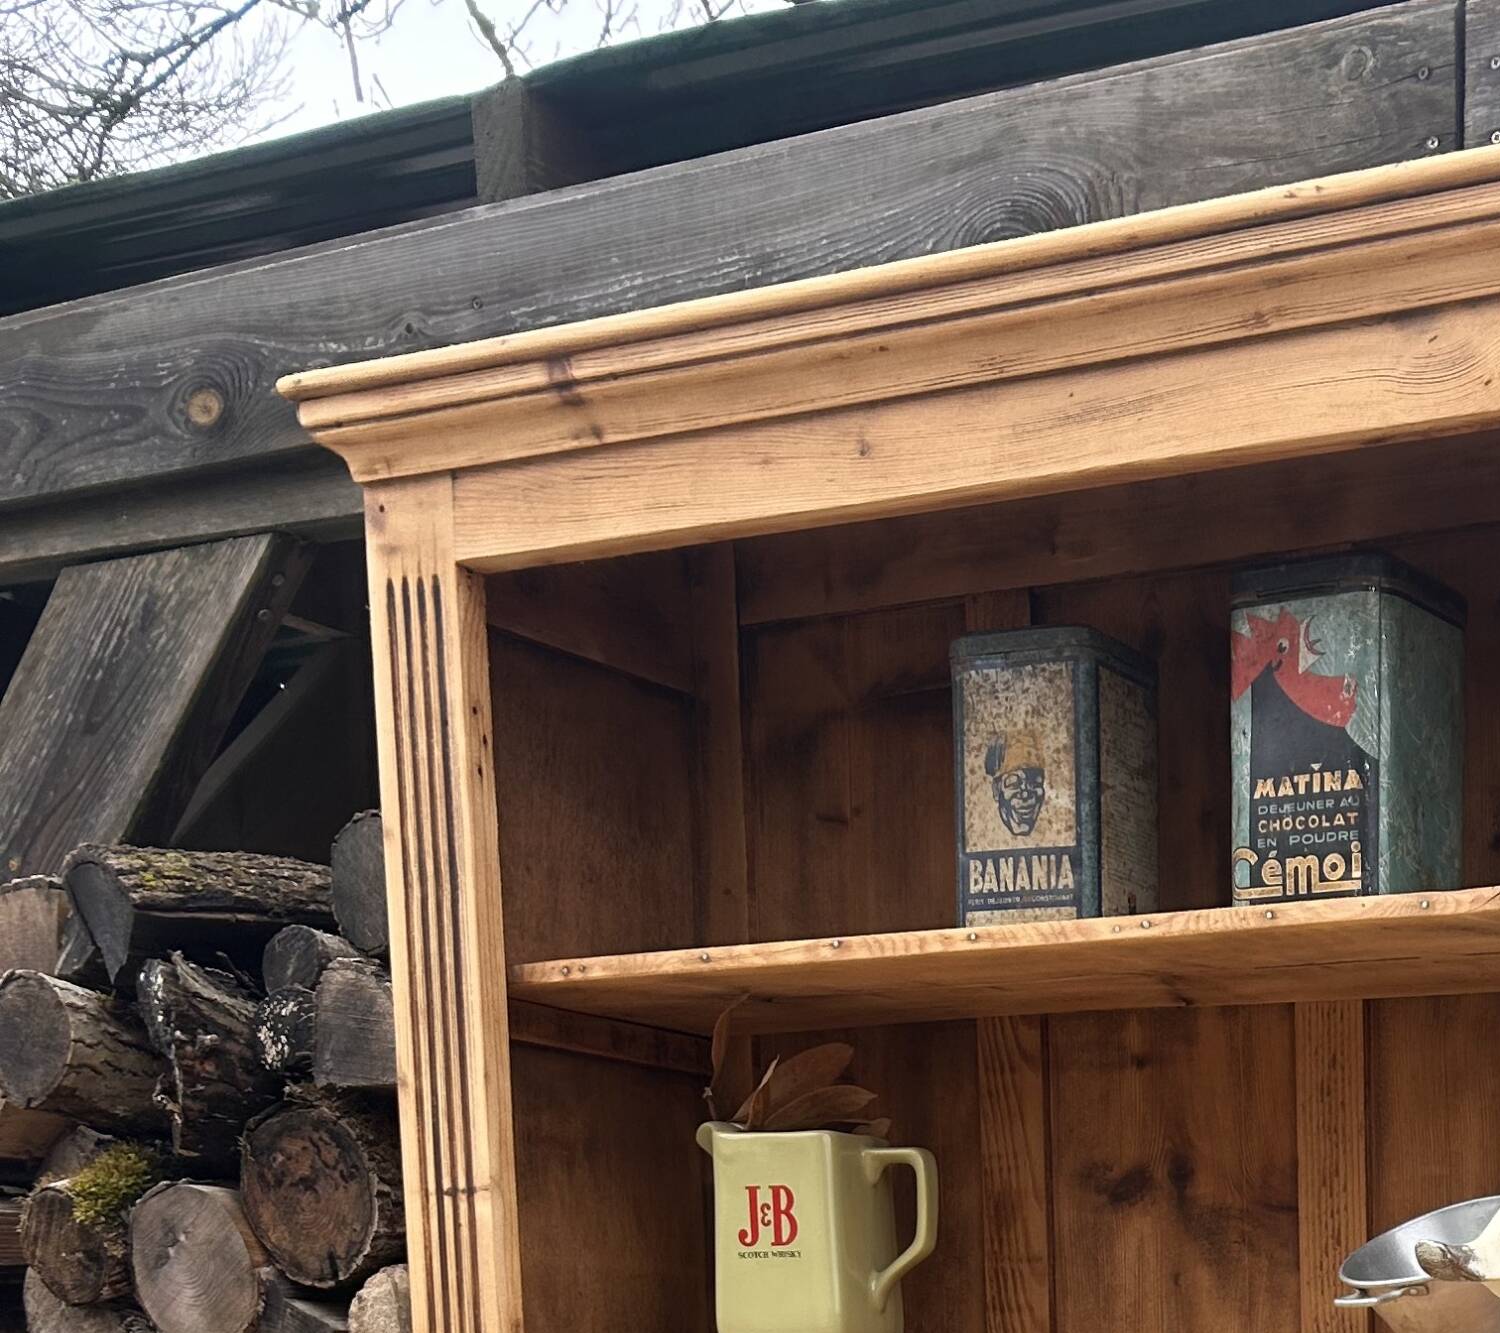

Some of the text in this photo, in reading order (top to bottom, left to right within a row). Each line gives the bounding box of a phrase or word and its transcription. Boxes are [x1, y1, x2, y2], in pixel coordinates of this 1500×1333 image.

[1253, 763, 1364, 800] MATINA
[1258, 811, 1359, 833] CHOCOLAT
[1257, 830, 1360, 849] EN POUDRE
[969, 854, 1074, 894] BANANIA
[738, 1184, 799, 1247] J&B
[738, 1251, 769, 1259] SCOTCH
